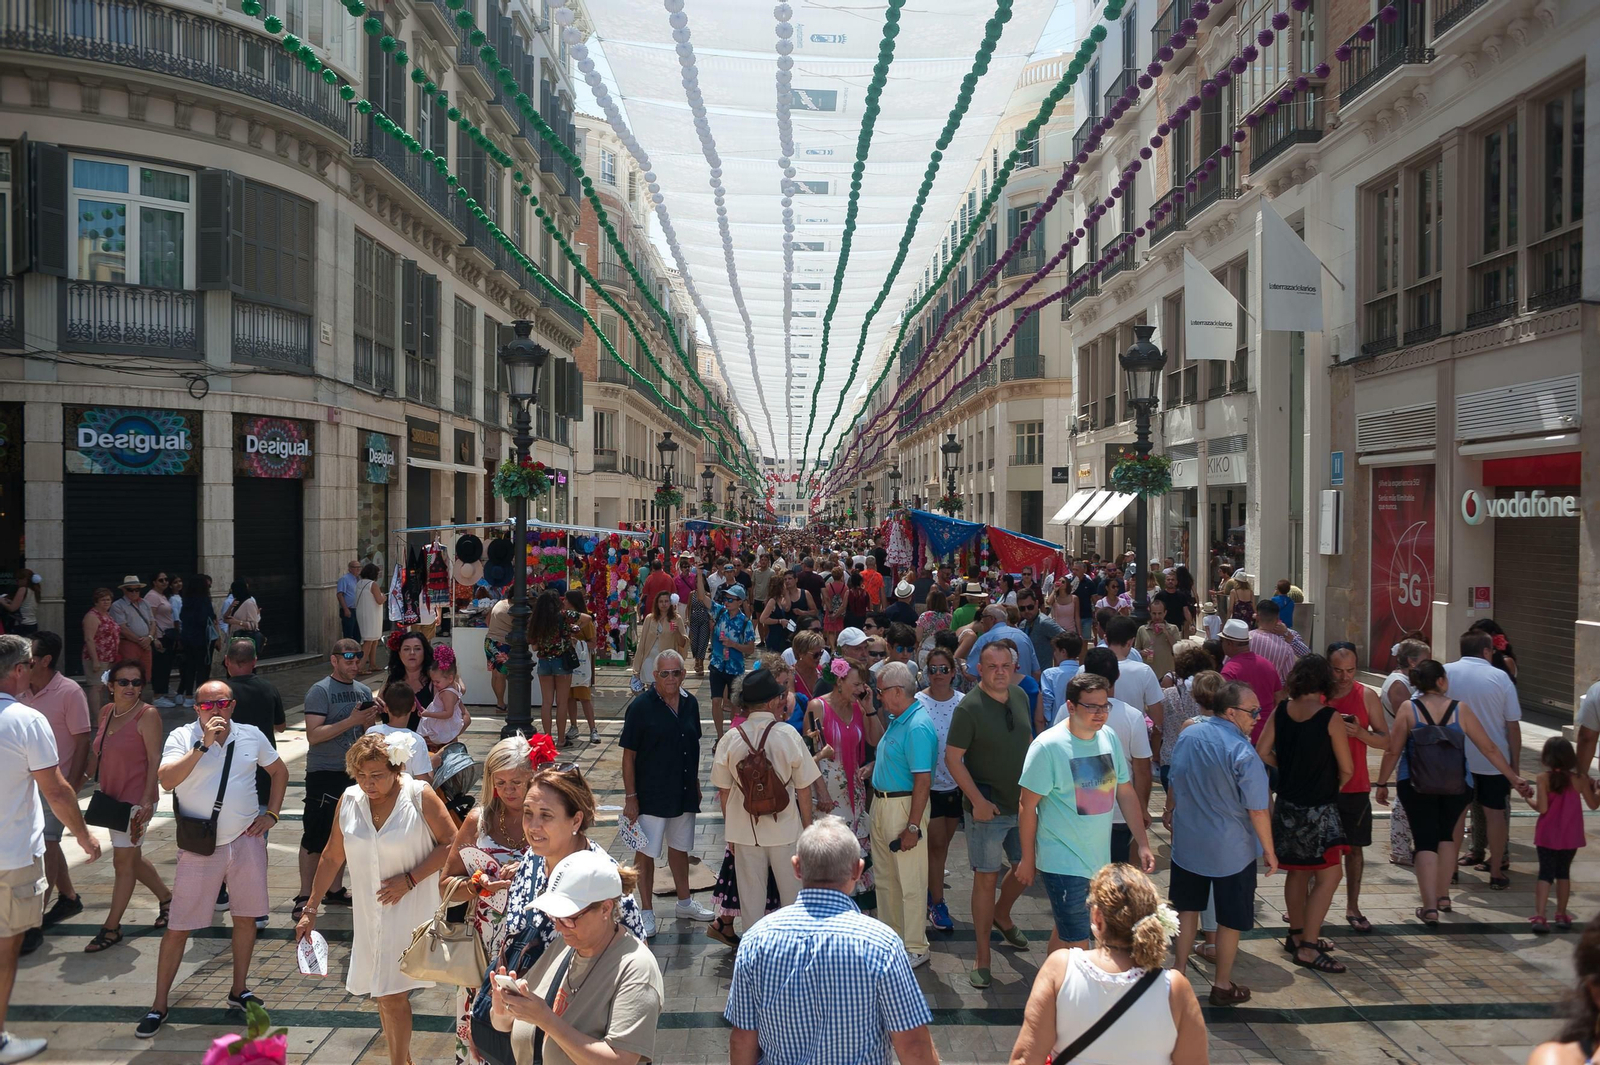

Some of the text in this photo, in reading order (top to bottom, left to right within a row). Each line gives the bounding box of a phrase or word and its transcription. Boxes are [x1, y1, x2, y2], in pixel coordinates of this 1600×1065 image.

[77, 428, 187, 454] Desigual
[245, 434, 309, 460] Desigual
[369, 447, 395, 468] Desigual
[1207, 456, 1230, 474] KIKO
[1486, 489, 1577, 518] vodafone
[1398, 572, 1422, 607] 5G
